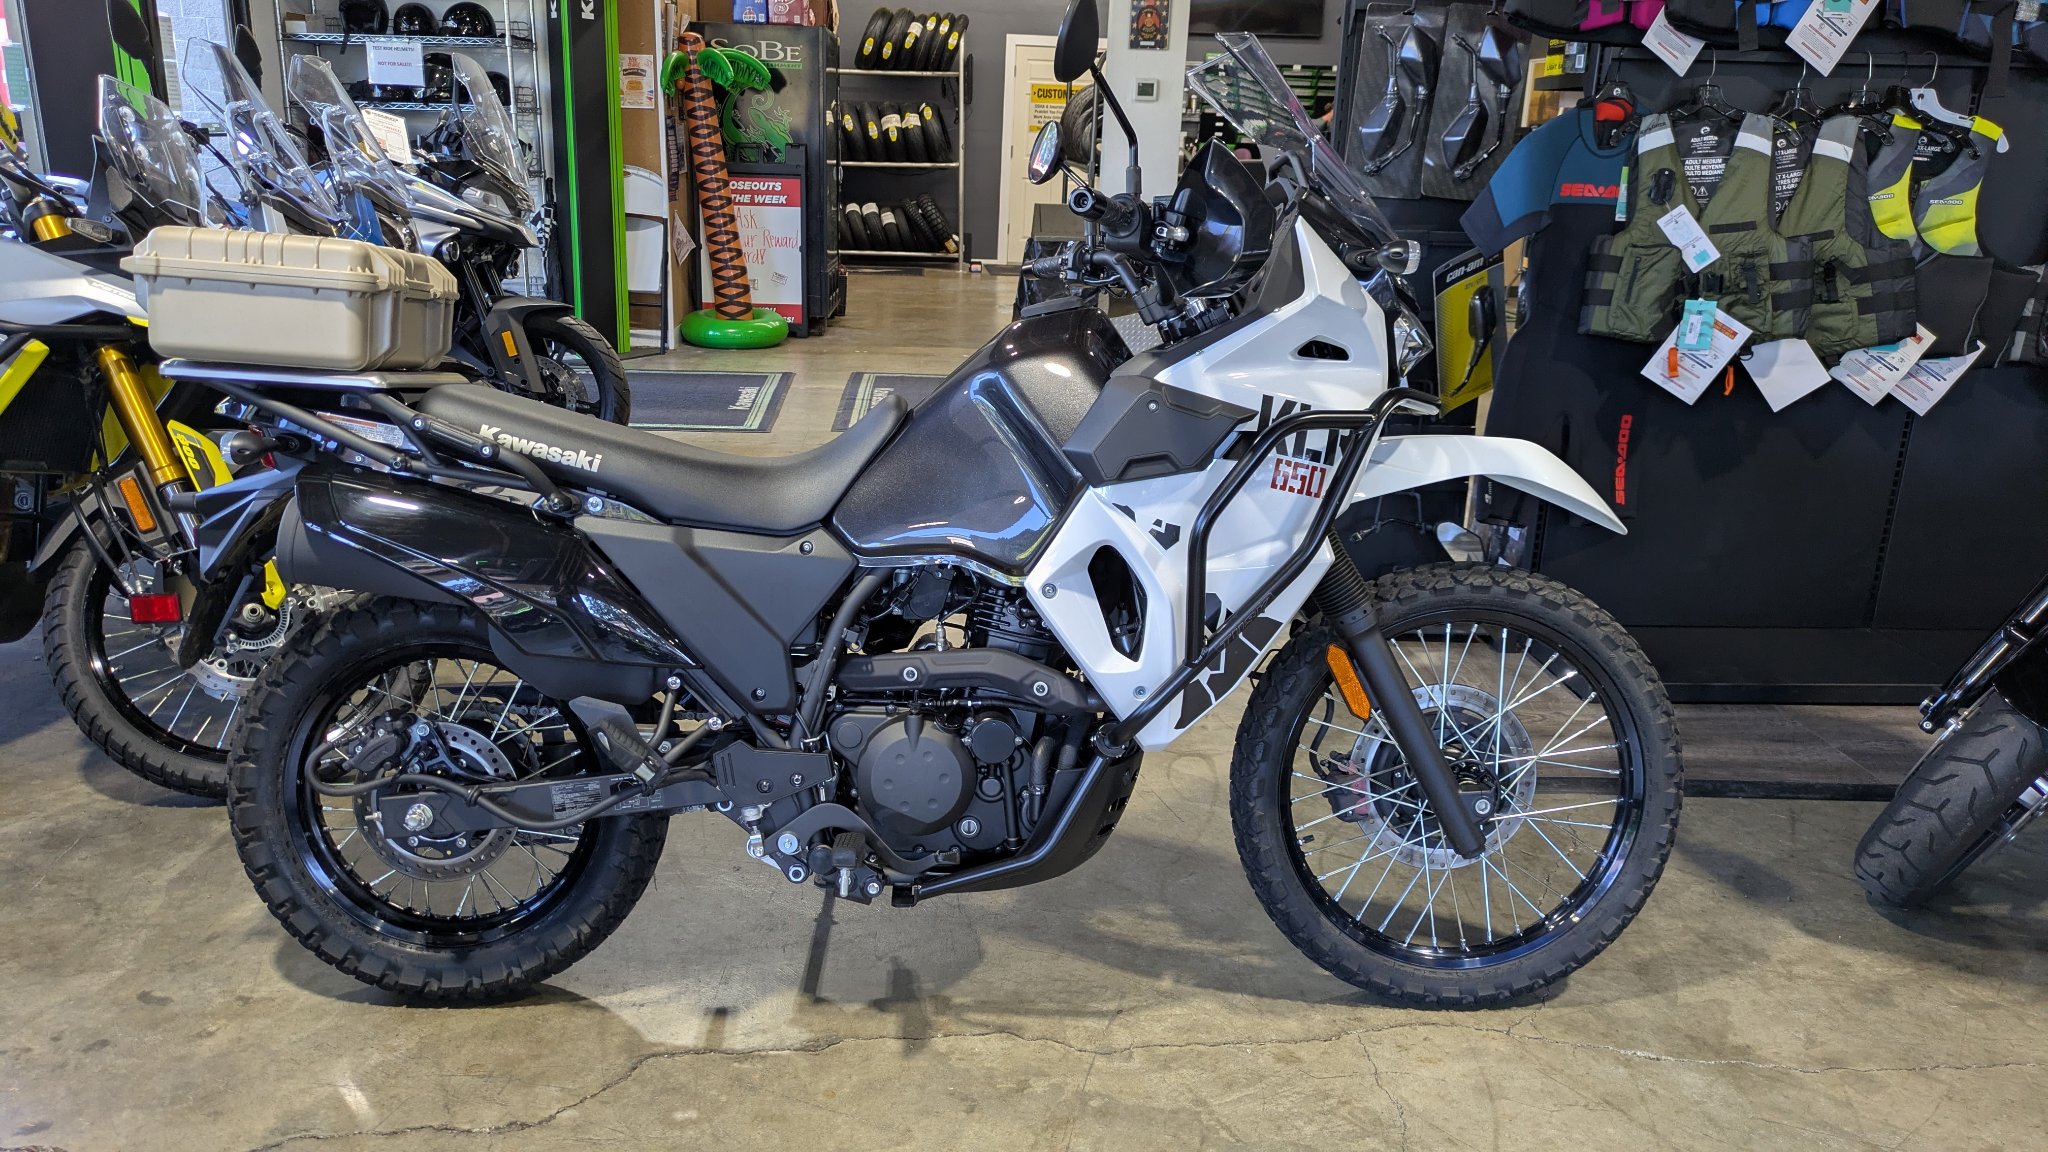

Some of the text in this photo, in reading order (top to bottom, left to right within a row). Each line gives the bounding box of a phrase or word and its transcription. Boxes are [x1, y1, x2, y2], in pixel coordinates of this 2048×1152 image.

[729, 181, 782, 191] OSEOUTS
[754, 194, 788, 205] WEEK
[1446, 257, 1485, 283] can-am
[480, 423, 603, 473] Kawasaki
[1270, 457, 1327, 499] 650
